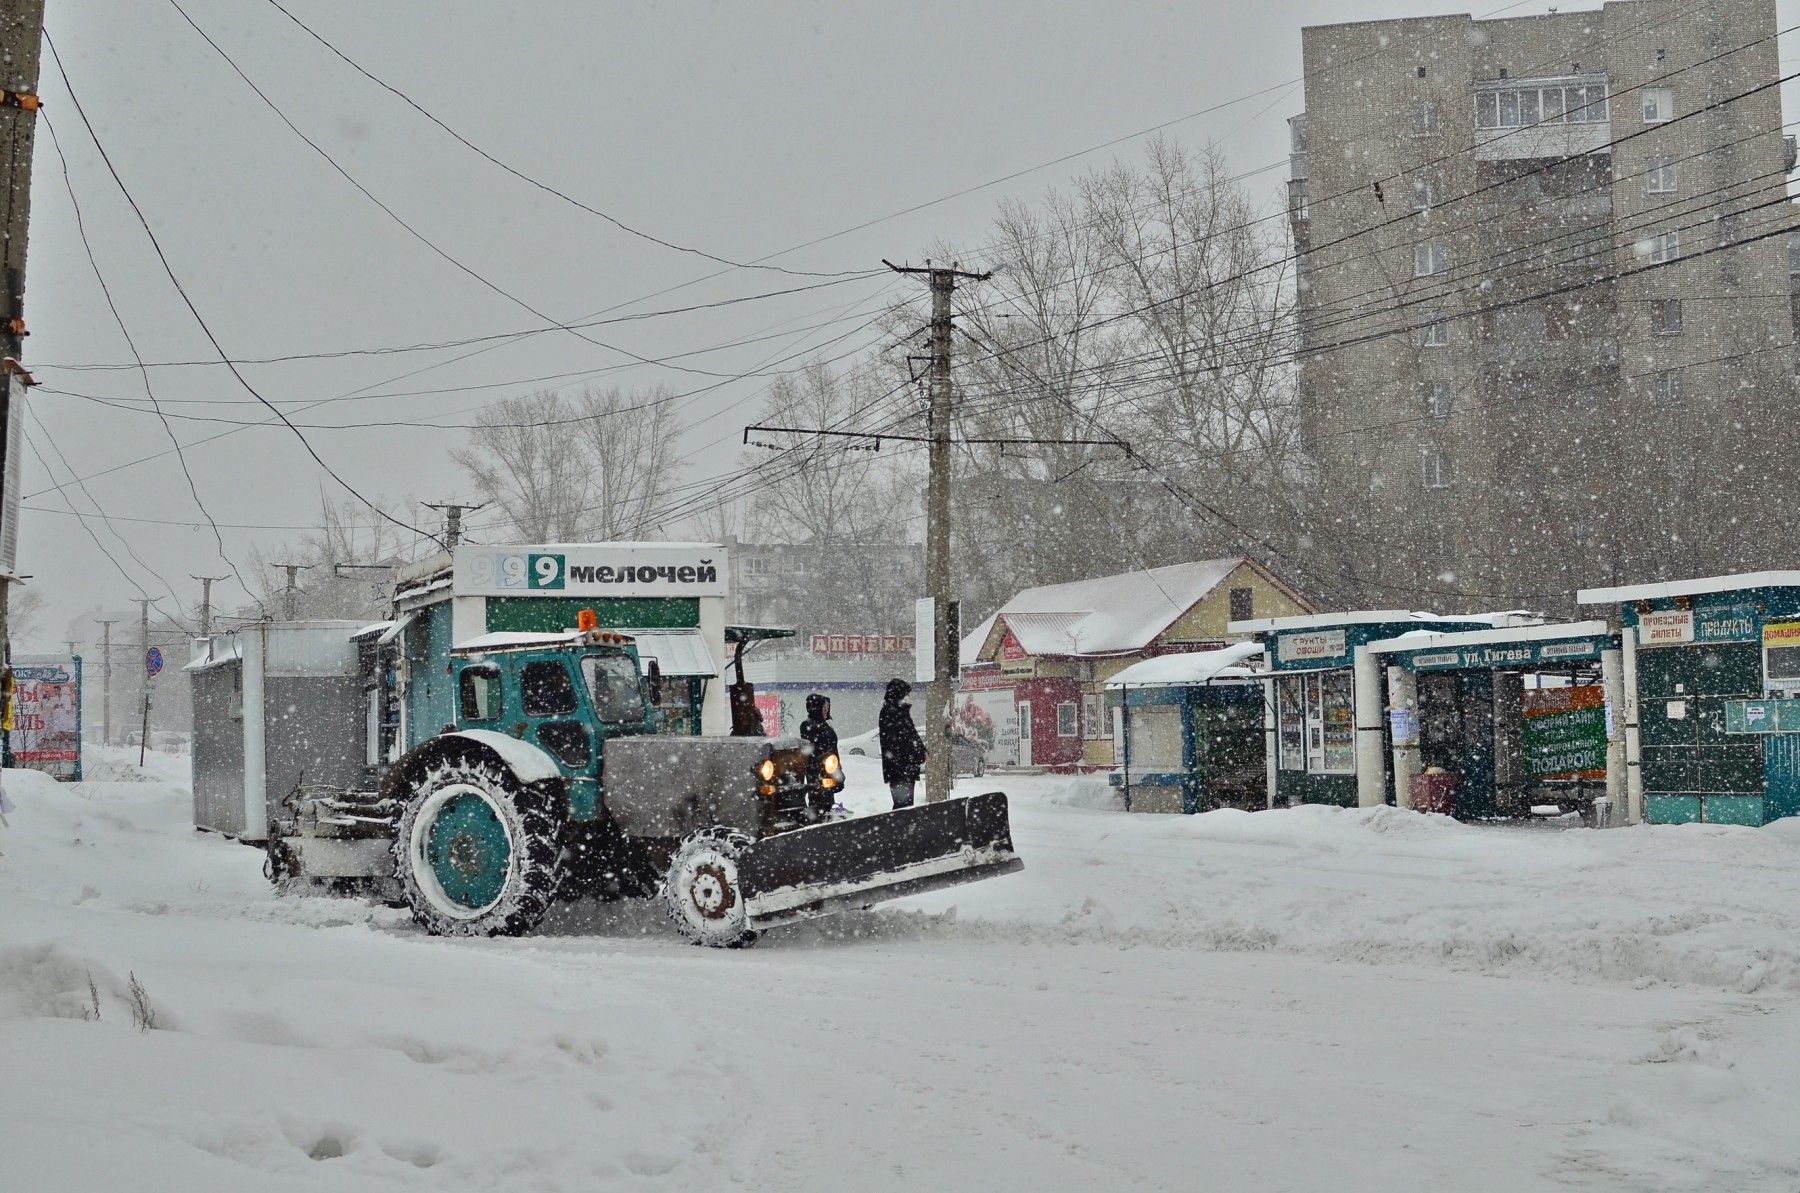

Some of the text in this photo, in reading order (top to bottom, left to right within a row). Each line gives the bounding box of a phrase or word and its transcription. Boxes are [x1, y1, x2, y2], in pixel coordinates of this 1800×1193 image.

[570, 559, 717, 584] мелочей
[1650, 628, 1682, 639] БИЛЕТЫ
[1701, 617, 1753, 637] ПРОДУКТЫ
[814, 637, 914, 652] АПТЕКА
[1296, 646, 1325, 655] ОВОЩИ
[1531, 751, 1596, 773] ПОДАРОК!
